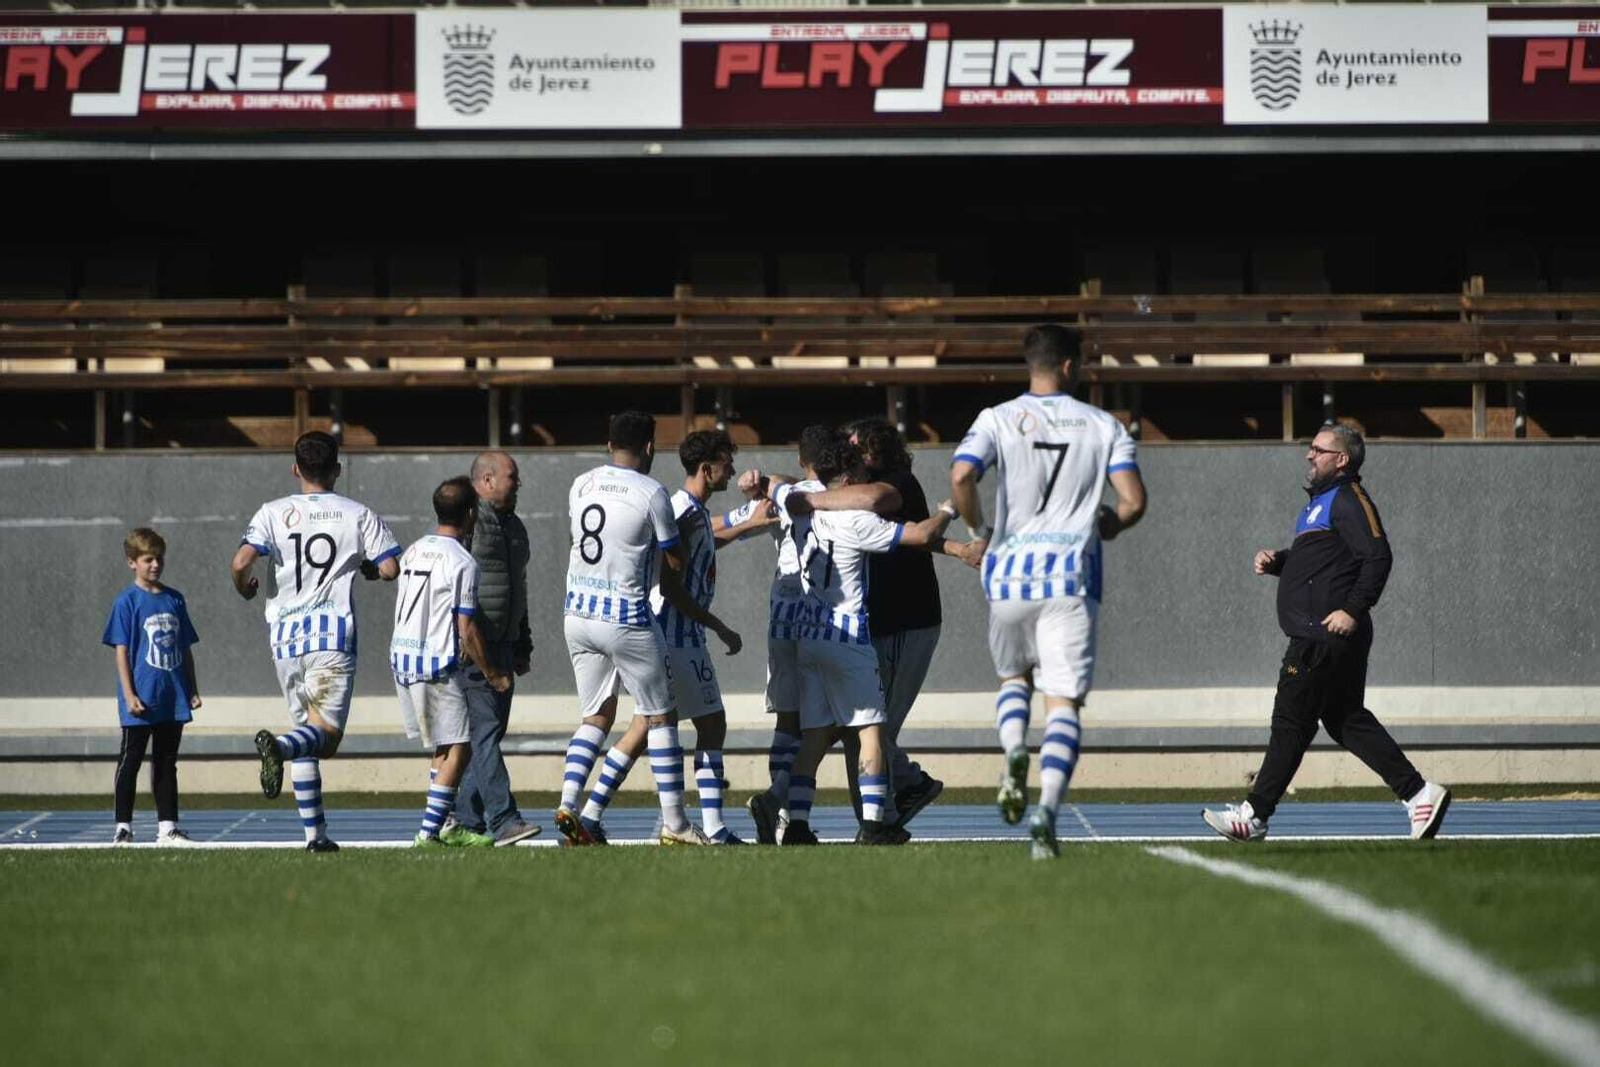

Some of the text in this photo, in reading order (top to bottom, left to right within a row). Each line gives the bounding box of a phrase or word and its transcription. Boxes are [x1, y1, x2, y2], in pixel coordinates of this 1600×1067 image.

[71, 27, 331, 116] JEREZ
[509, 53, 655, 72] Ayuntamiento
[715, 23, 1134, 112] PLAY JEREZ
[1316, 49, 1462, 67] Ayuntamiento
[509, 76, 590, 94] de Jerez
[1316, 70, 1398, 89] de Jerez
[1032, 442, 1069, 515] 7
[309, 510, 343, 521] NEBUR
[580, 503, 606, 565] 8
[287, 533, 337, 595] 19
[397, 569, 431, 624] 17
[690, 658, 713, 683] 16
